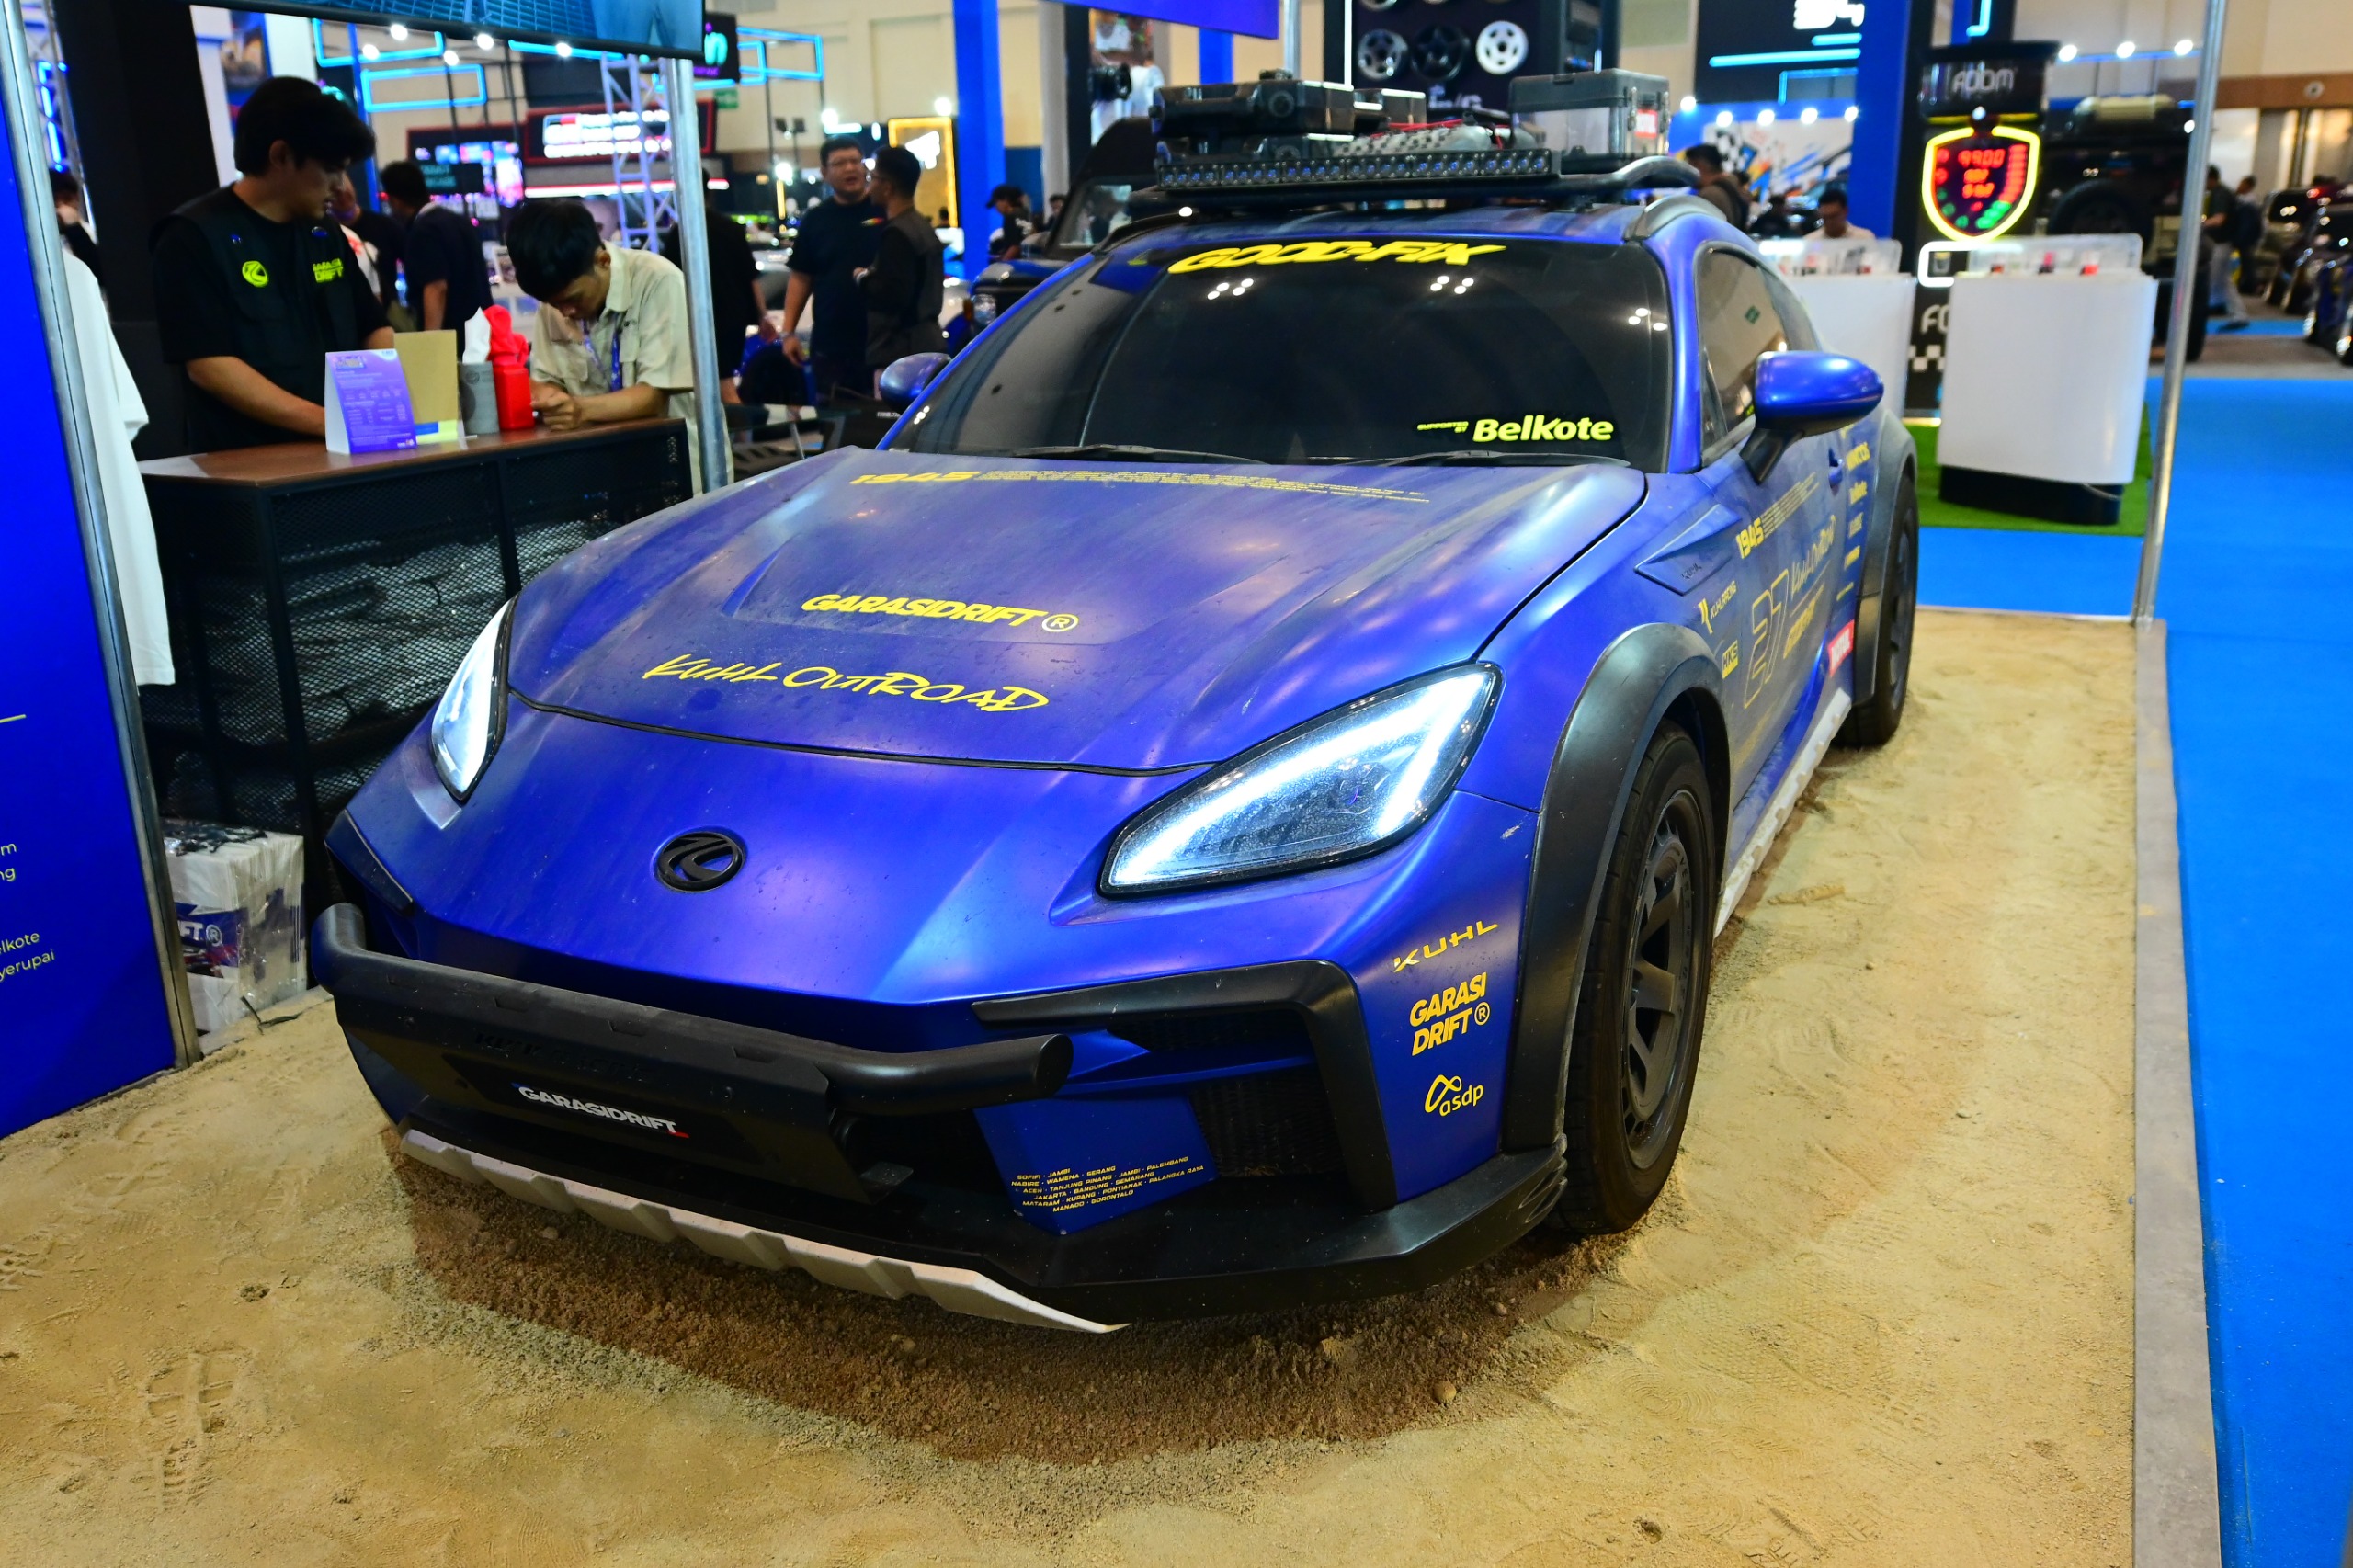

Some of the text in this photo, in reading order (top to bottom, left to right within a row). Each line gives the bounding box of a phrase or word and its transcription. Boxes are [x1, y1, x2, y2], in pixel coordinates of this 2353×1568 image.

[1472, 415, 1615, 442] Belkote
[1736, 517, 1764, 559] 1945
[801, 594, 1048, 626] GARASIDRIFT
[0, 932, 40, 955] lkote
[1393, 921, 1498, 972] KUHL
[1409, 971, 1487, 1027] GARASI
[1412, 1007, 1473, 1056] DRIFT
[518, 1086, 676, 1133] GARASIDRIFT
[1439, 1084, 1483, 1117] asdp
[1033, 1172, 1154, 1200] JAKARTA BANDUNG SEMARANG
[1046, 1174, 1079, 1185] WAMENA
[1086, 1165, 1116, 1176] SERANG
[1048, 1168, 1071, 1177] JAMBI
[1050, 1181, 1083, 1192] TANJUNG
[1086, 1175, 1112, 1185] PINANG
[1119, 1168, 1141, 1177] JAMBI
[1146, 1156, 1188, 1171] PALEMBANG
[1066, 1192, 1096, 1202] KUPANG
[1102, 1181, 1142, 1195] PONTIANAK
[1149, 1171, 1185, 1184] PALANGKA
[1187, 1165, 1204, 1174] RAYA
[1052, 1189, 1134, 1212] MANADO GORONTALO
